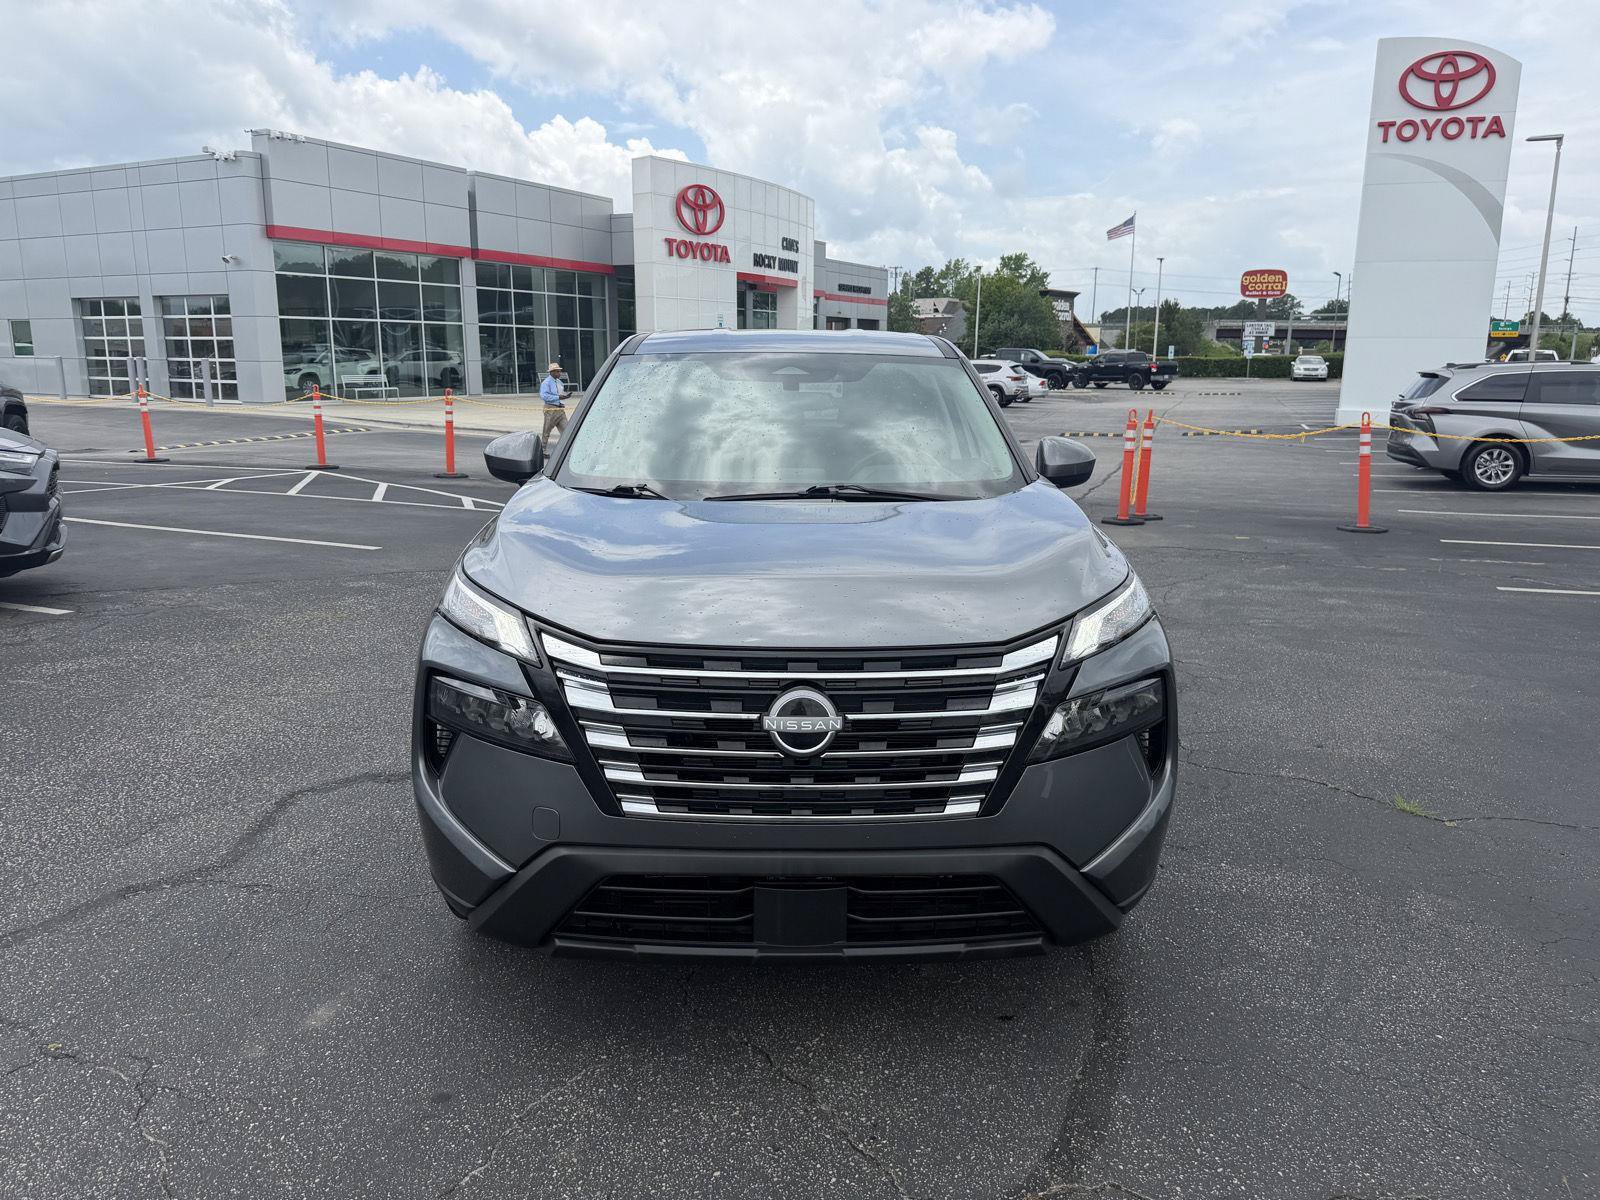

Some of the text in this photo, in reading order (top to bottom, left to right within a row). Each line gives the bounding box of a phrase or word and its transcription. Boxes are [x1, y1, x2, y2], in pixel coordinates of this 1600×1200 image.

[1378, 115, 1506, 143] TOYOTA
[664, 237, 731, 263] TOYOTA
[753, 253, 799, 274] ROCKY MOUNT
[1242, 274, 1282, 286] golden
[1248, 281, 1286, 291] corral
[765, 719, 841, 730] NISSAN
